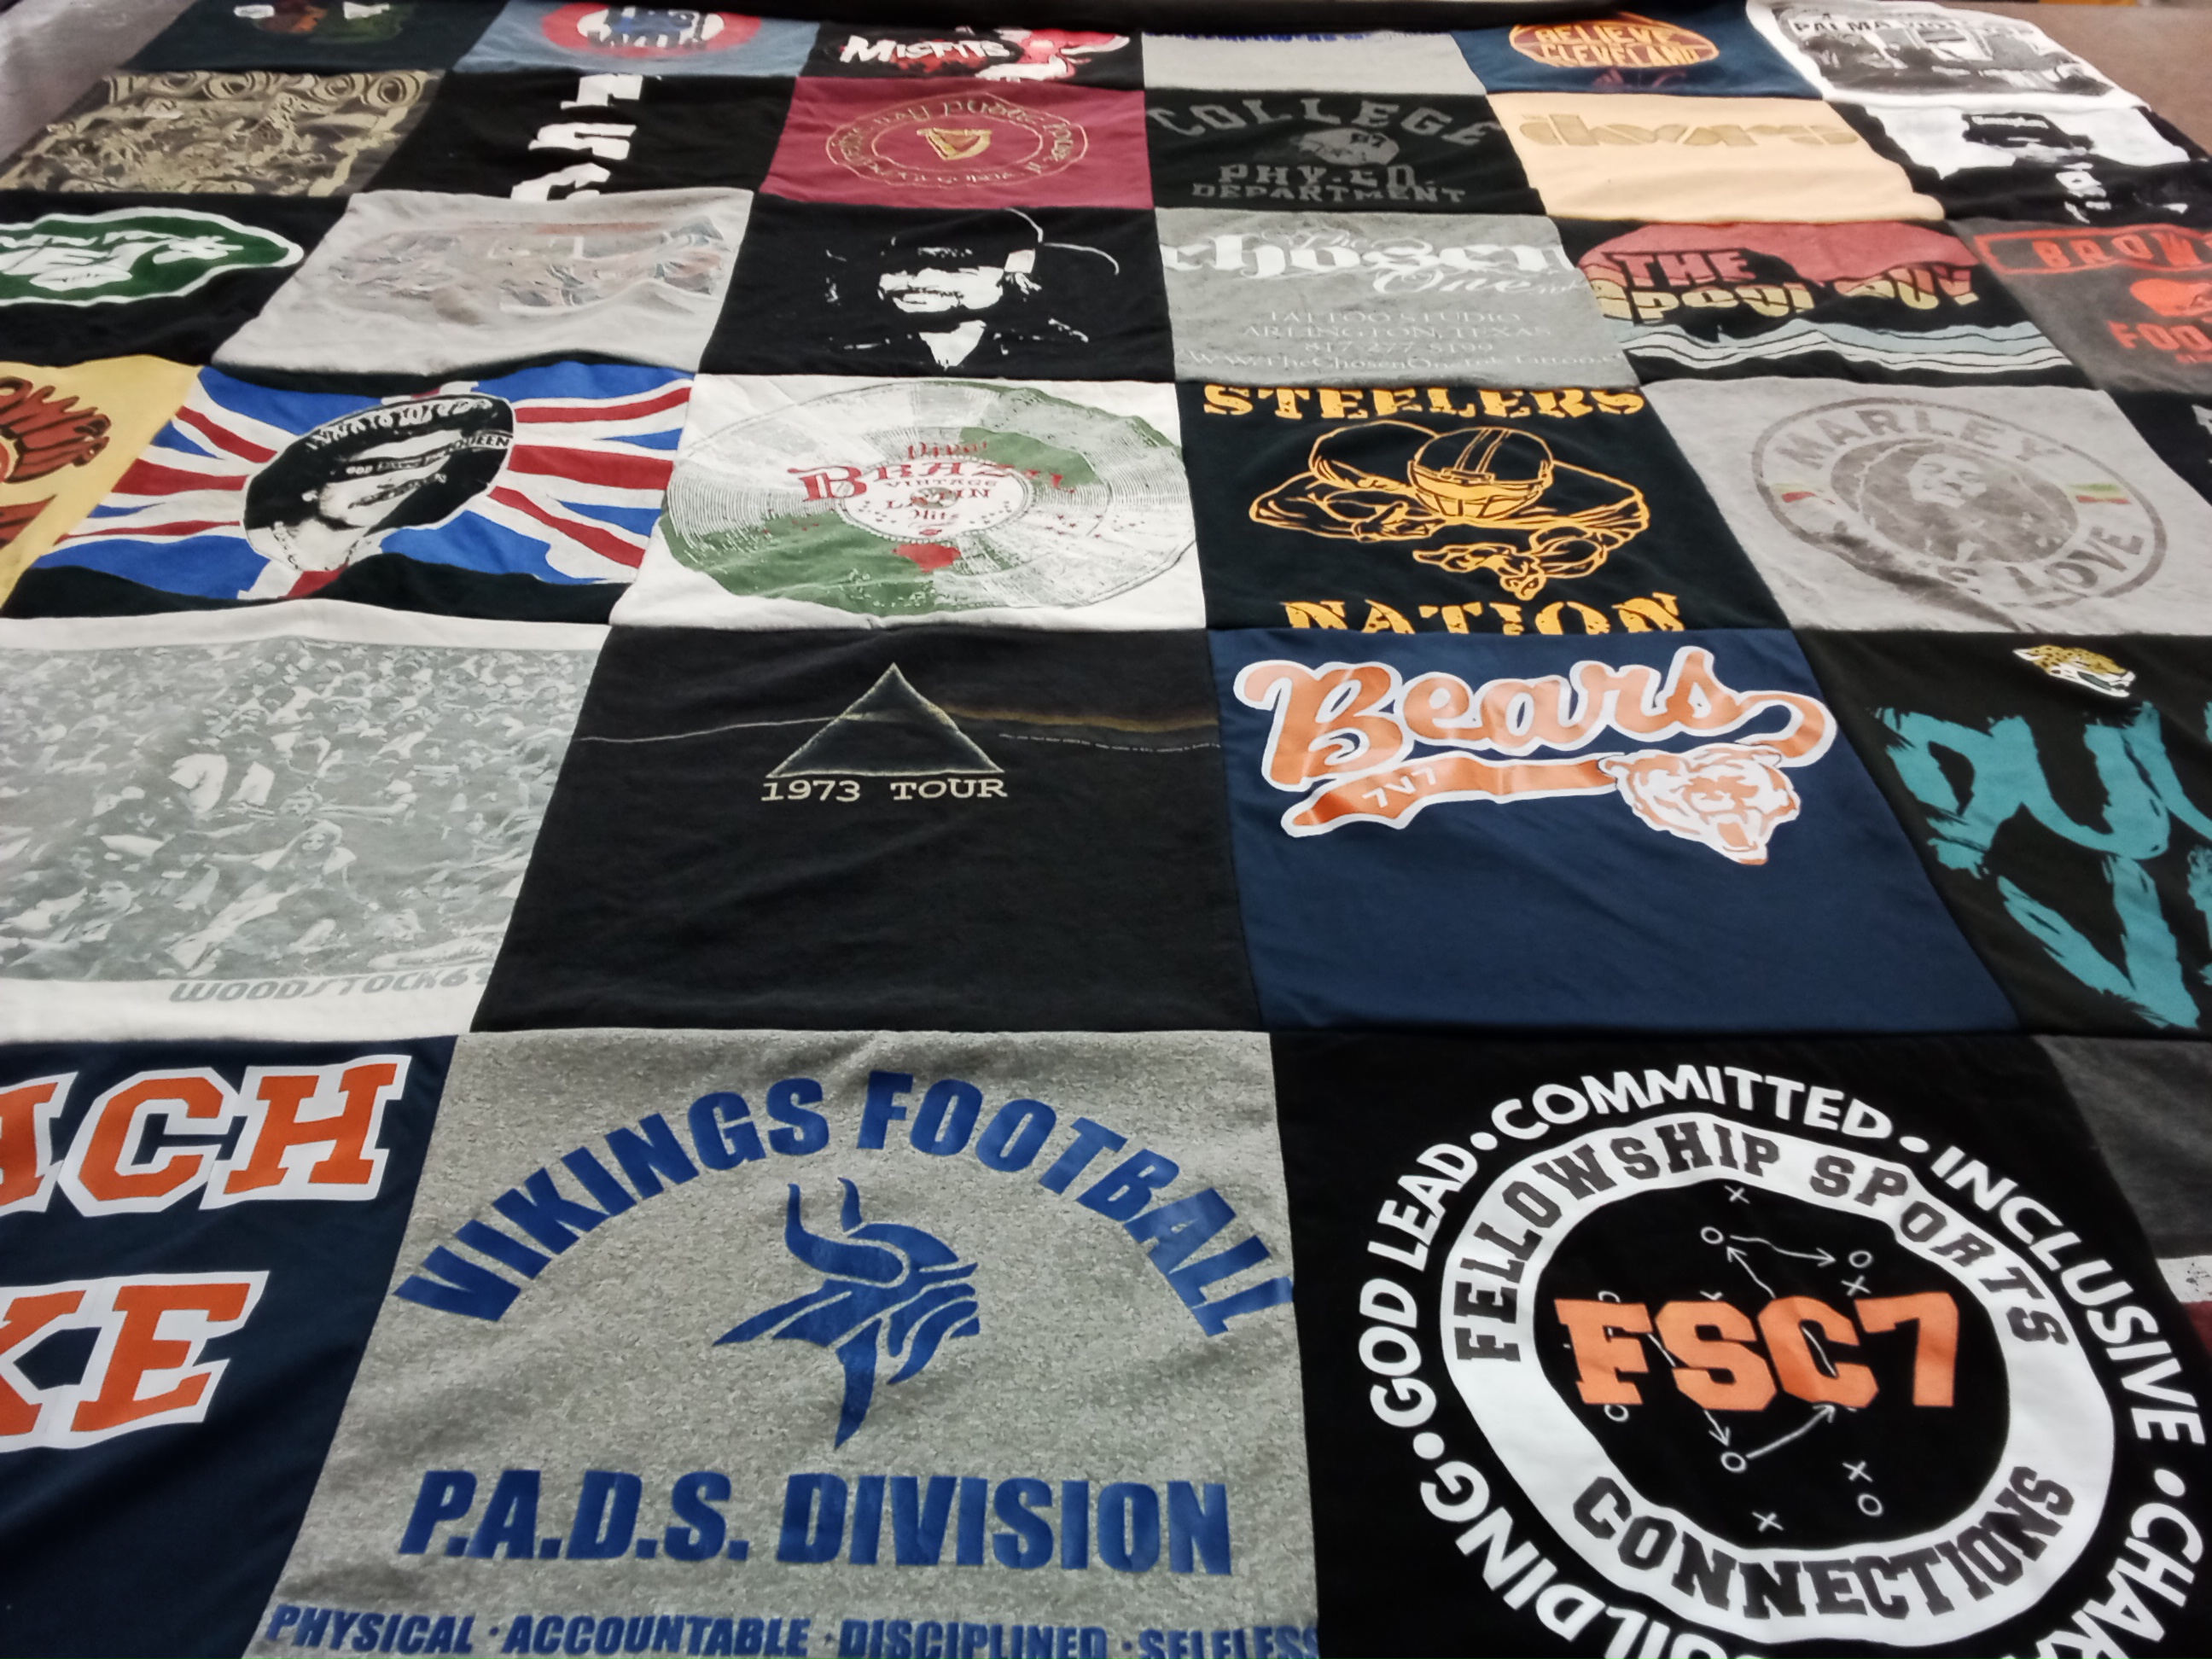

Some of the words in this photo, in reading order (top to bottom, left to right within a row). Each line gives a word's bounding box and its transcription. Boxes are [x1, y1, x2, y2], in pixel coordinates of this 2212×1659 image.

[1540, 43, 1702, 67] CLEVELAND
[1146, 97, 1504, 146] COLLEGE
[1193, 182, 1465, 203] DEPARTMENT
[1610, 250, 1756, 288] THE
[1267, 310, 1392, 323] TATTOO
[1399, 311, 1522, 323] STUDIO
[1451, 326, 1551, 339] TEXAS
[1203, 384, 1645, 420] STEELERS
[1777, 408, 2060, 470] MARLEY
[2005, 526, 2145, 597] LOVE
[1284, 591, 1685, 635] NATION
[1234, 646, 1838, 792] Bears
[760, 780, 861, 803] 1973
[889, 777, 1008, 801] TOUR
[1491, 1063, 1895, 1142] COMMITTED
[393, 1077, 831, 1323] VIKINGS
[857, 1069, 1295, 1338] FOOTBALL
[1367, 1140, 1476, 1272] LEAD
[1453, 1121, 1780, 1365] FELLOWSHIP
[1810, 1154, 2070, 1348] SPORTS
[1930, 1144, 2208, 1447] INCLUSIVE
[1359, 1278, 1439, 1430] GOD
[1553, 1291, 1959, 1412] FSC7
[399, 1470, 750, 1563] P.A.D.S.
[775, 1472, 1233, 1575] DIVISION
[1573, 1464, 2076, 1621] CONNECTIONS
[2000, 1502, 2203, 1659] CHAR
[265, 1604, 474, 1656] PHYSICAL
[503, 1614, 812, 1658] ACCOUNTABLE
[838, 1618, 1107, 1659] DISCIPLINED
